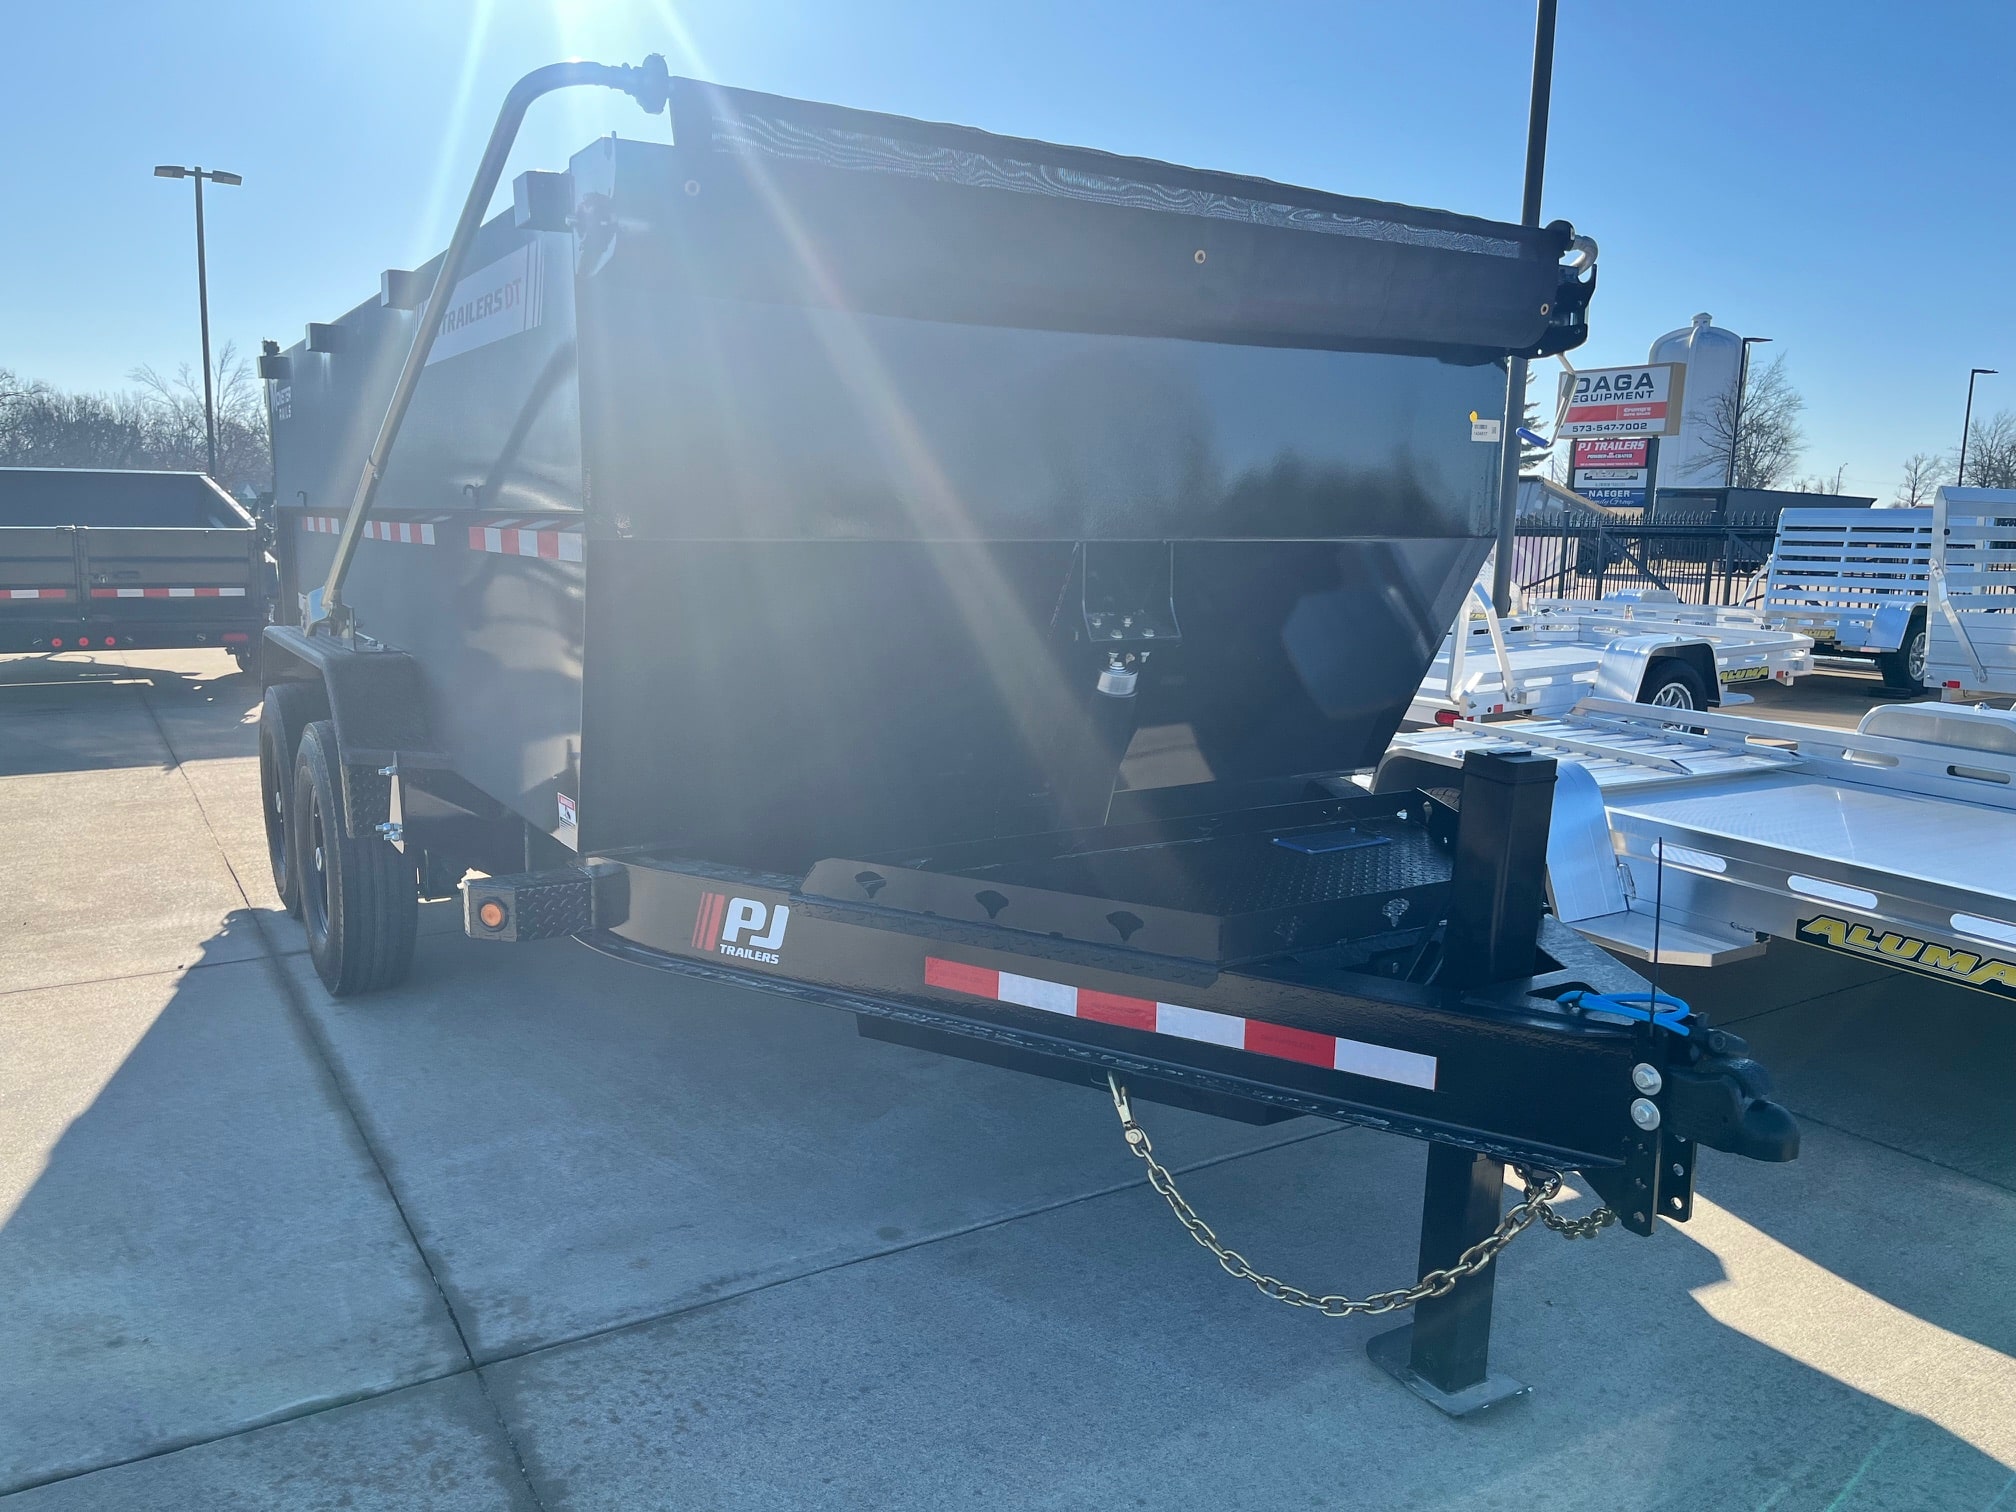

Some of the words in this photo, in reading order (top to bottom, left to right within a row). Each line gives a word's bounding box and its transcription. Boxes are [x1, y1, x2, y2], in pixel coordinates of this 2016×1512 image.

[441, 287, 503, 336] TRAILERS
[504, 278, 522, 309] DT
[1574, 373, 1654, 393] DAGA
[1572, 390, 1654, 403] EQUIPMENT
[1572, 422, 1648, 433] 573-547-7002
[1577, 442, 1592, 451] PJ
[1594, 440, 1645, 451] TRAILERS
[1588, 490, 1631, 498] NAEGER
[1720, 666, 1769, 681] ALUMA
[722, 897, 790, 950] PJ
[719, 943, 780, 965] TRAILERS
[1801, 915, 2016, 988] ALUMA
